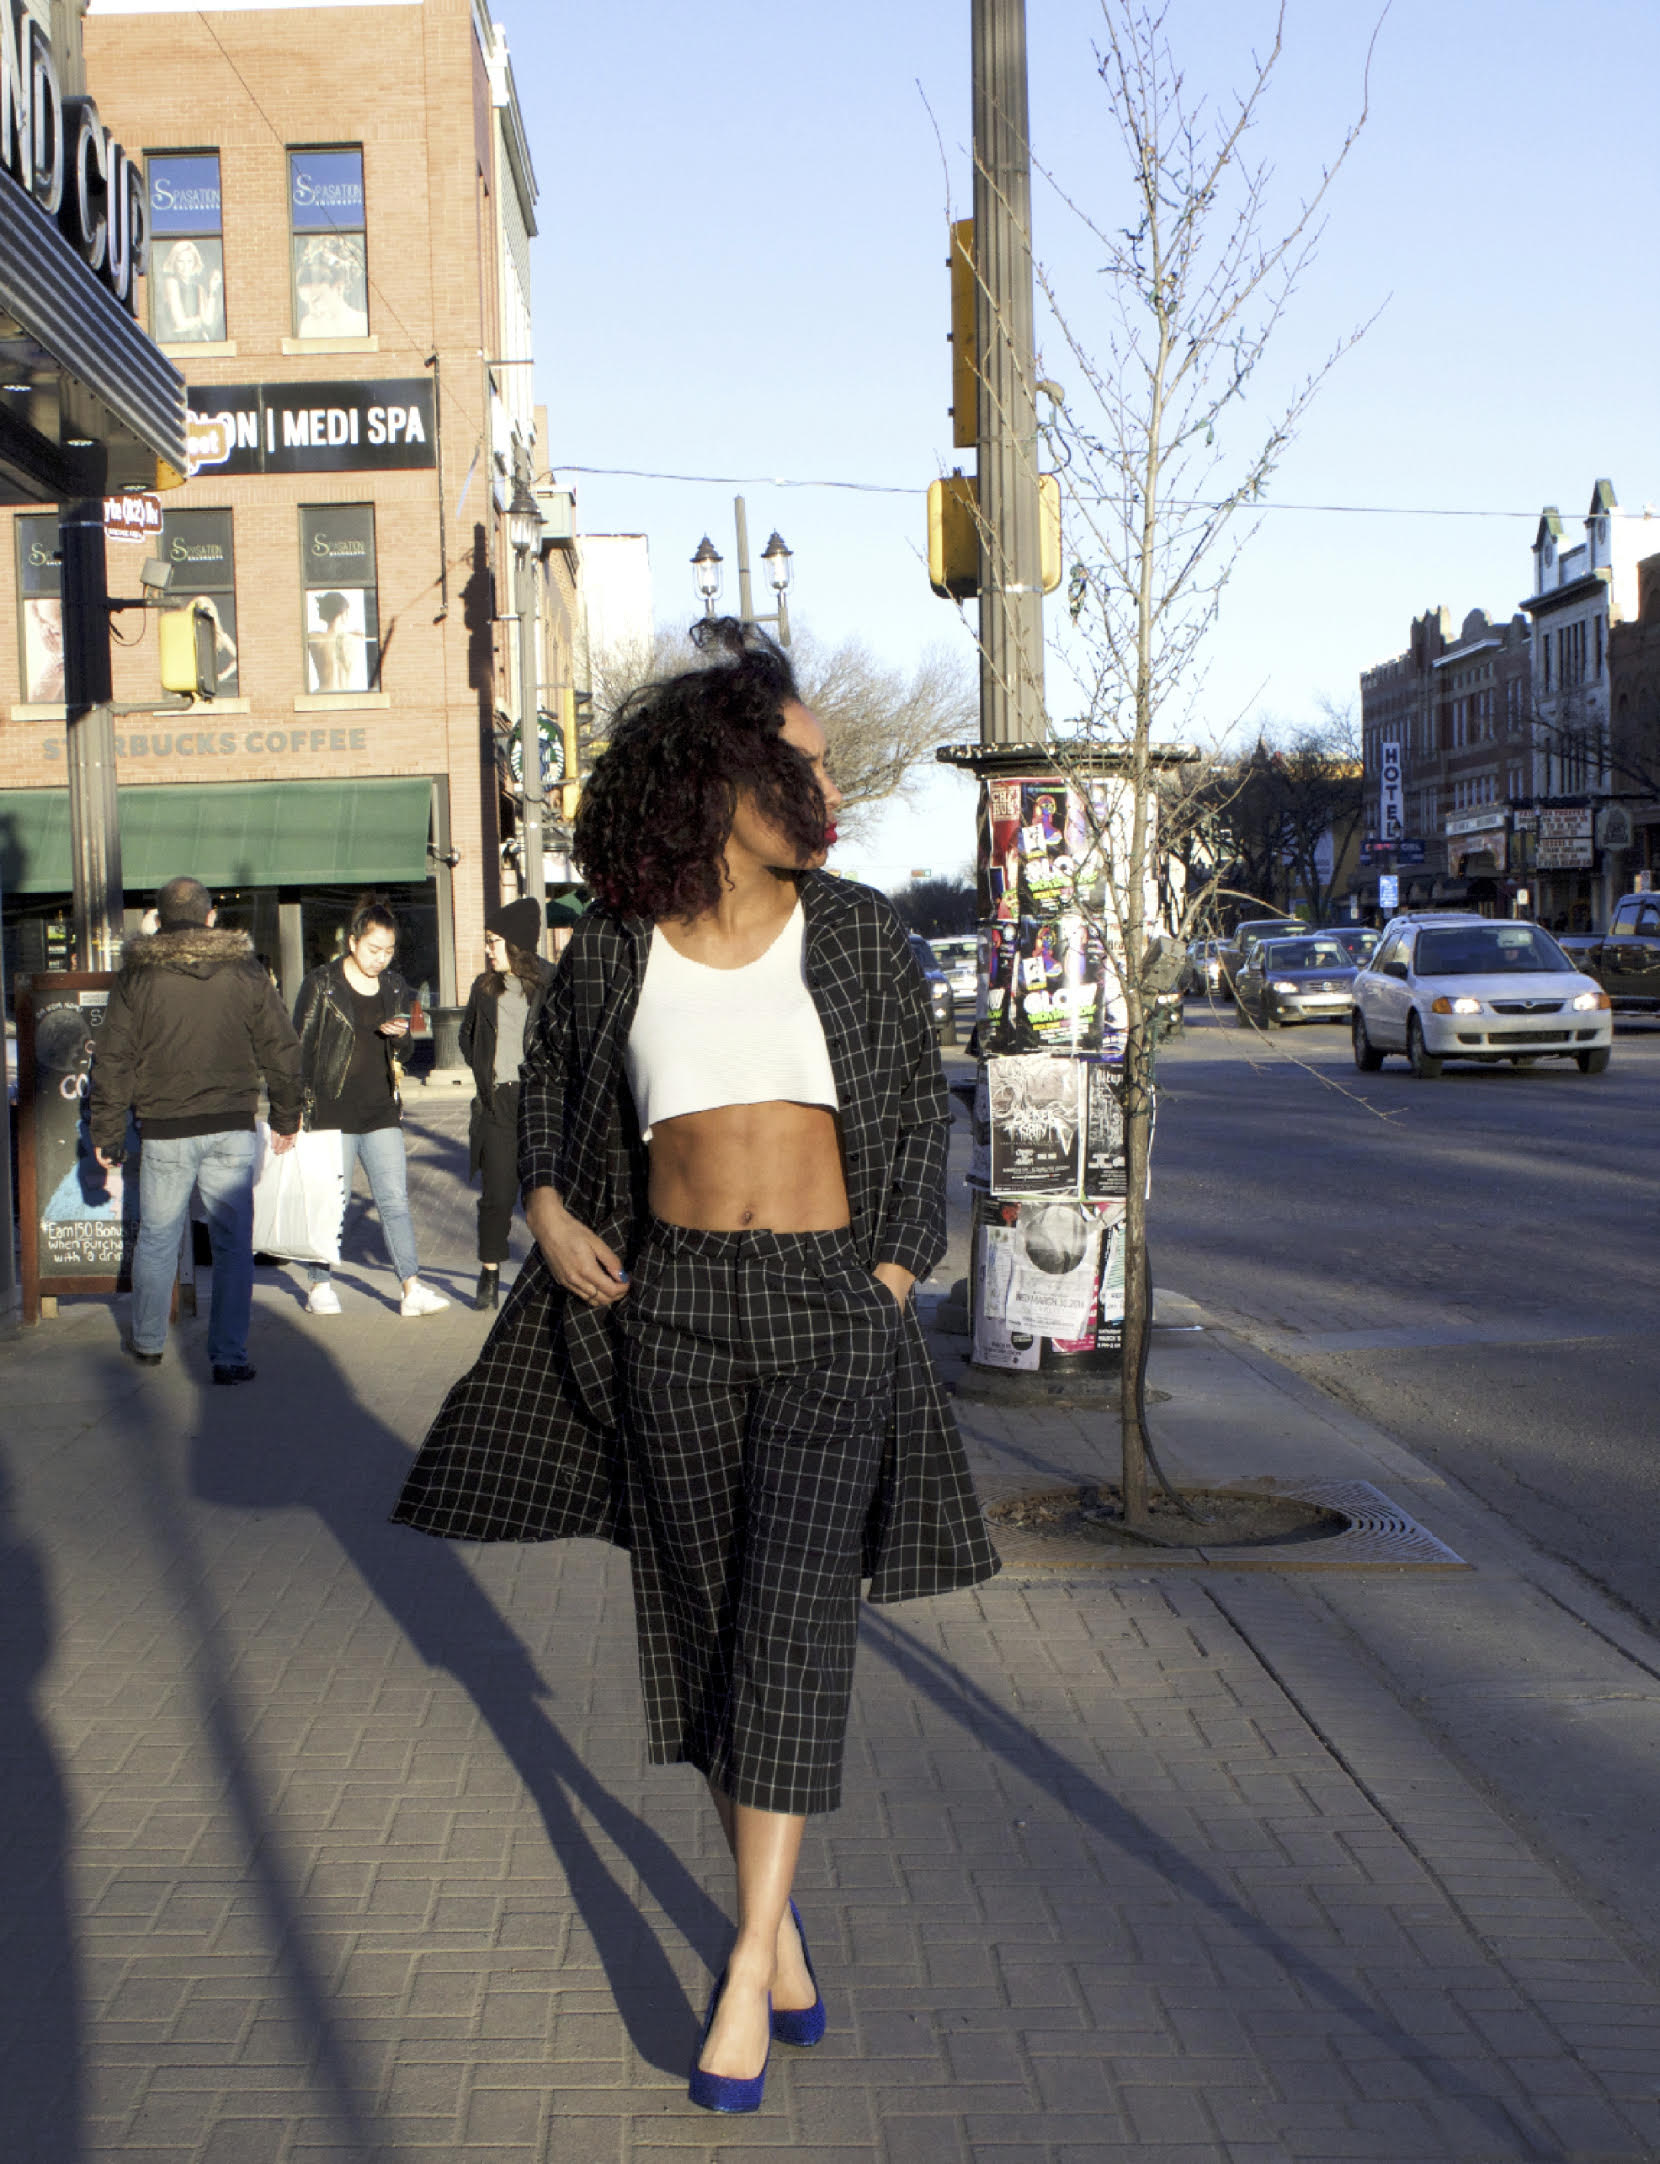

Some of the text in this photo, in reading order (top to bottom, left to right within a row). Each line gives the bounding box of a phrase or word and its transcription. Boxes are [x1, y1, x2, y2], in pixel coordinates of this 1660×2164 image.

[283, 408, 359, 447] MEDI
[367, 406, 426, 444] SPA
[244, 727, 367, 752] COFFEE
[1384, 748, 1400, 838] HOTEL
